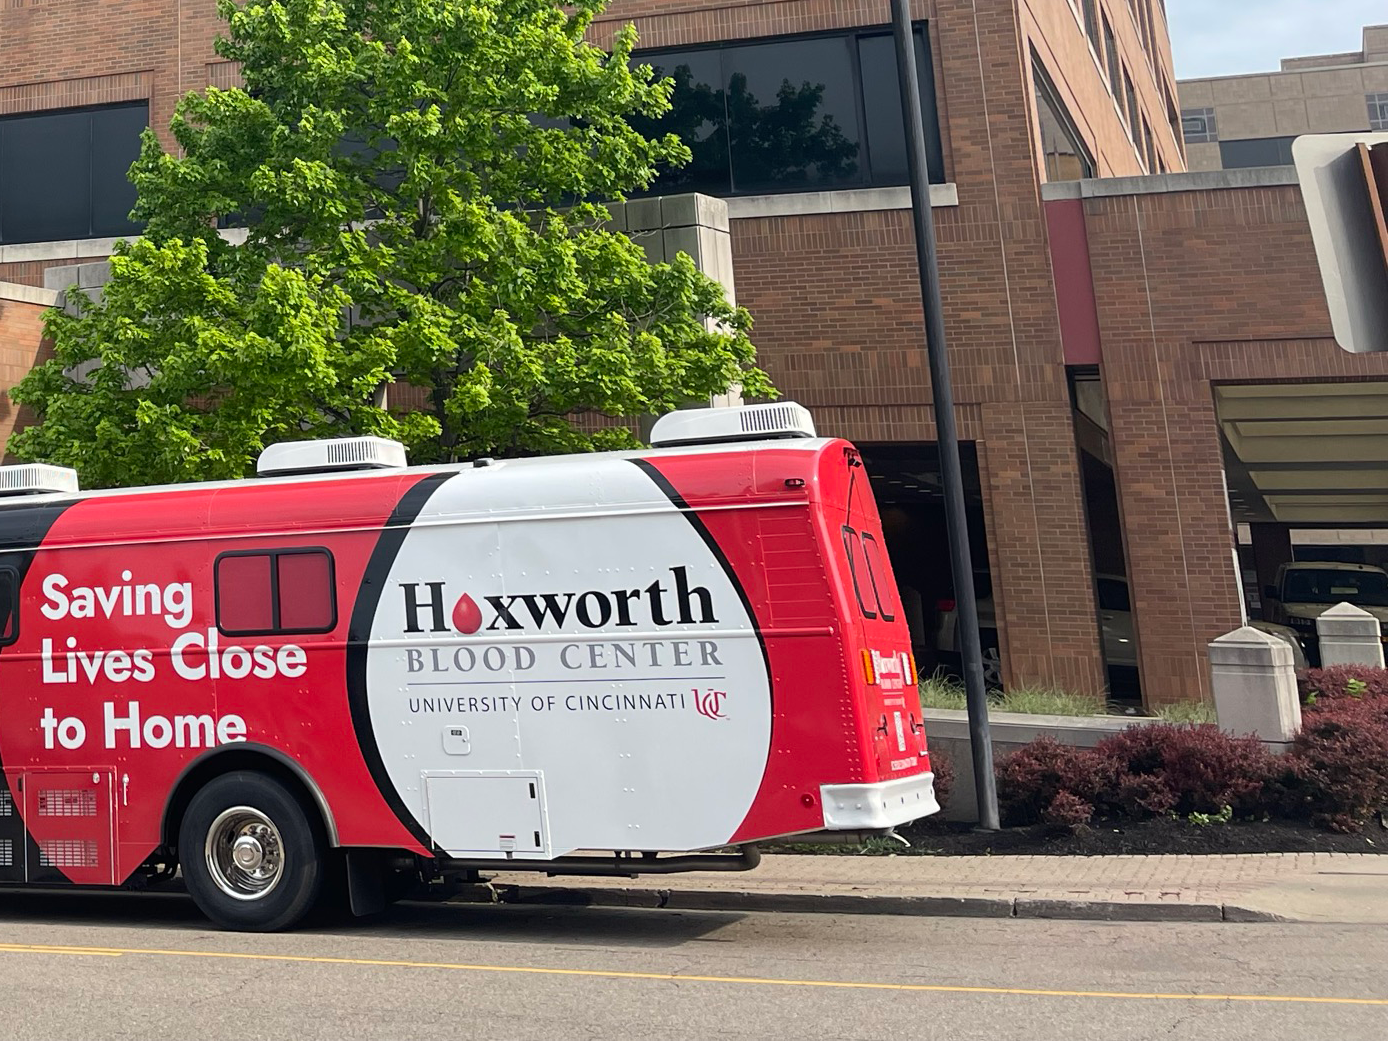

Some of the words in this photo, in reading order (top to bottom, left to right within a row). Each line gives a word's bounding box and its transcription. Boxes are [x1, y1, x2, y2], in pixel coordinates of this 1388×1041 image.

[40, 570, 193, 628] Saving
[41, 637, 155, 686] Lives
[170, 627, 308, 680] Close
[406, 646, 536, 674] BLOOD
[560, 640, 724, 670] CENTER
[40, 707, 86, 750] to
[103, 701, 247, 749] Home
[408, 695, 522, 714] UNIVERSITY
[531, 694, 558, 712] OF
[565, 692, 686, 712] CINCINNATI
